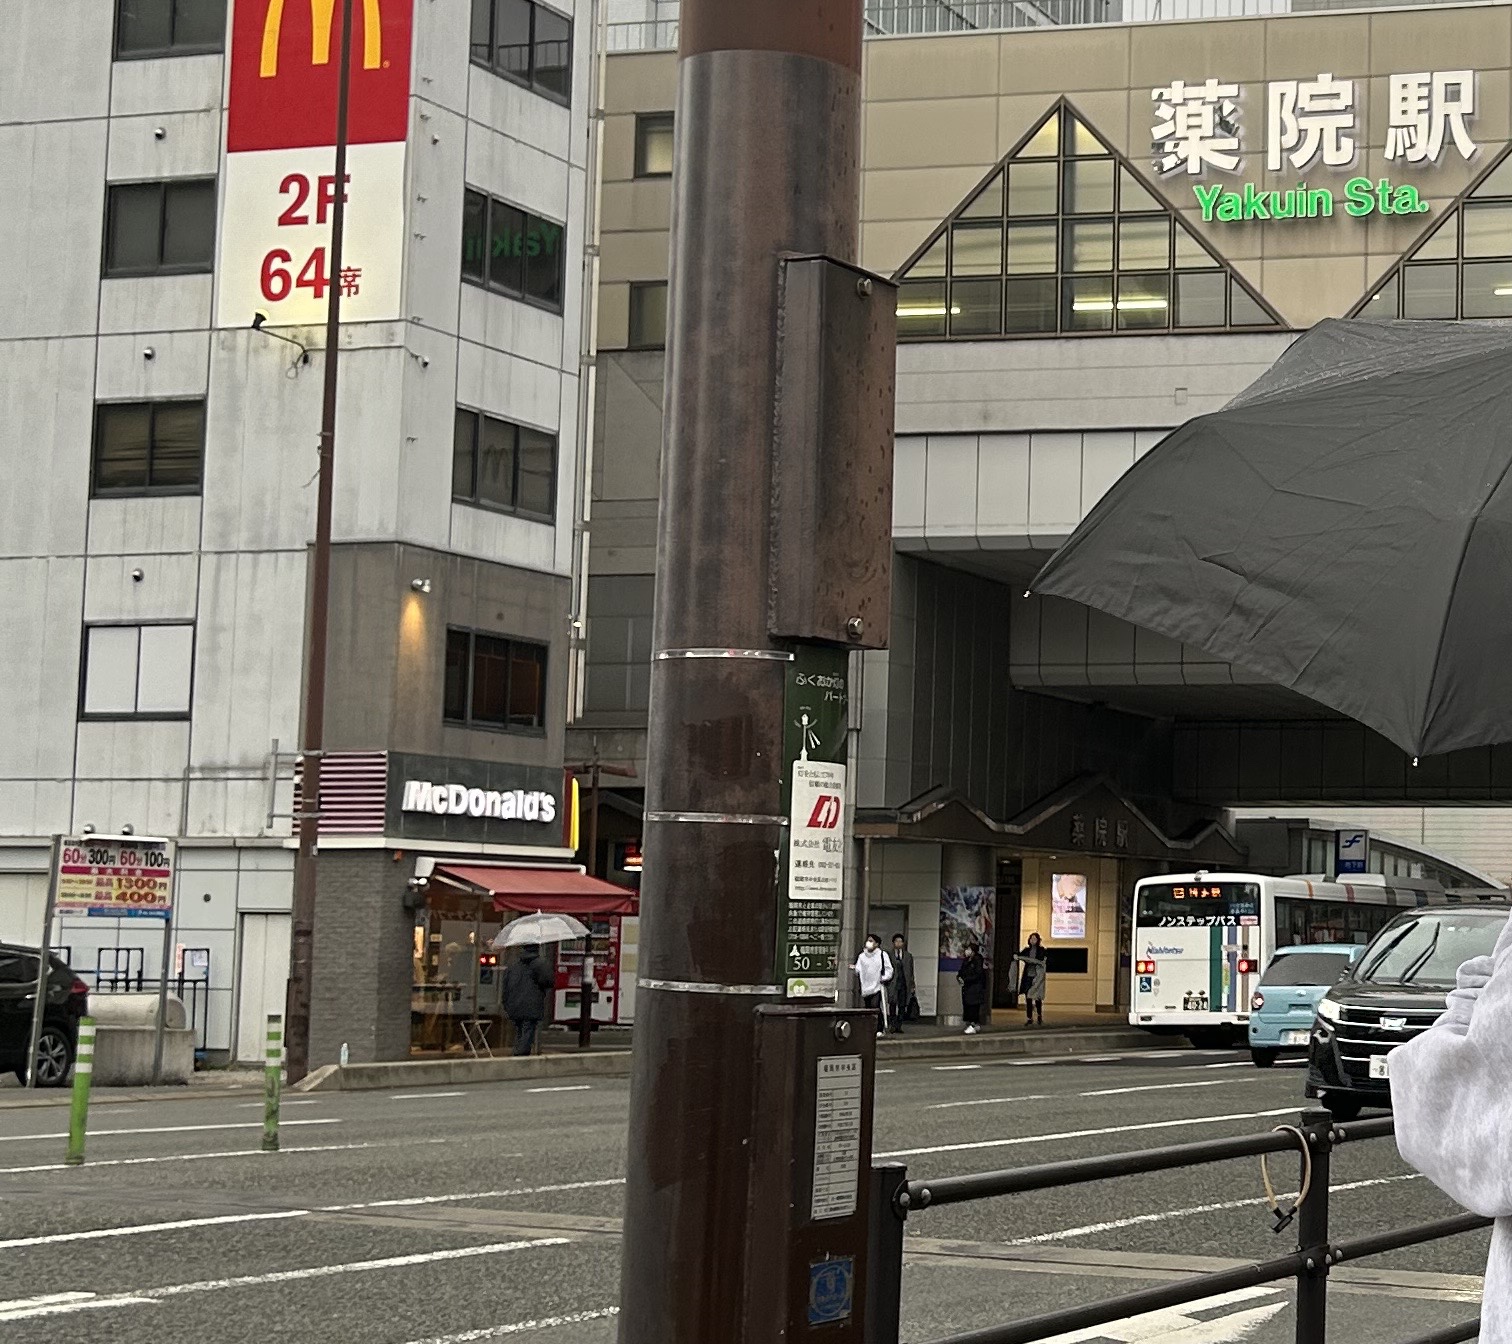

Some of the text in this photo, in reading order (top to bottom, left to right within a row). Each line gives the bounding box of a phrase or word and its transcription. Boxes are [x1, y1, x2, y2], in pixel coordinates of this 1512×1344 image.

[1150, 69, 1477, 174] 薬院駅
[277, 173, 350, 227] 2F
[1192, 176, 1430, 223] Yakuin Sta.
[402, 780, 556, 823] McDonald's
[1159, 916, 1237, 926] ノンステップバス
[793, 956, 810, 970] 50
